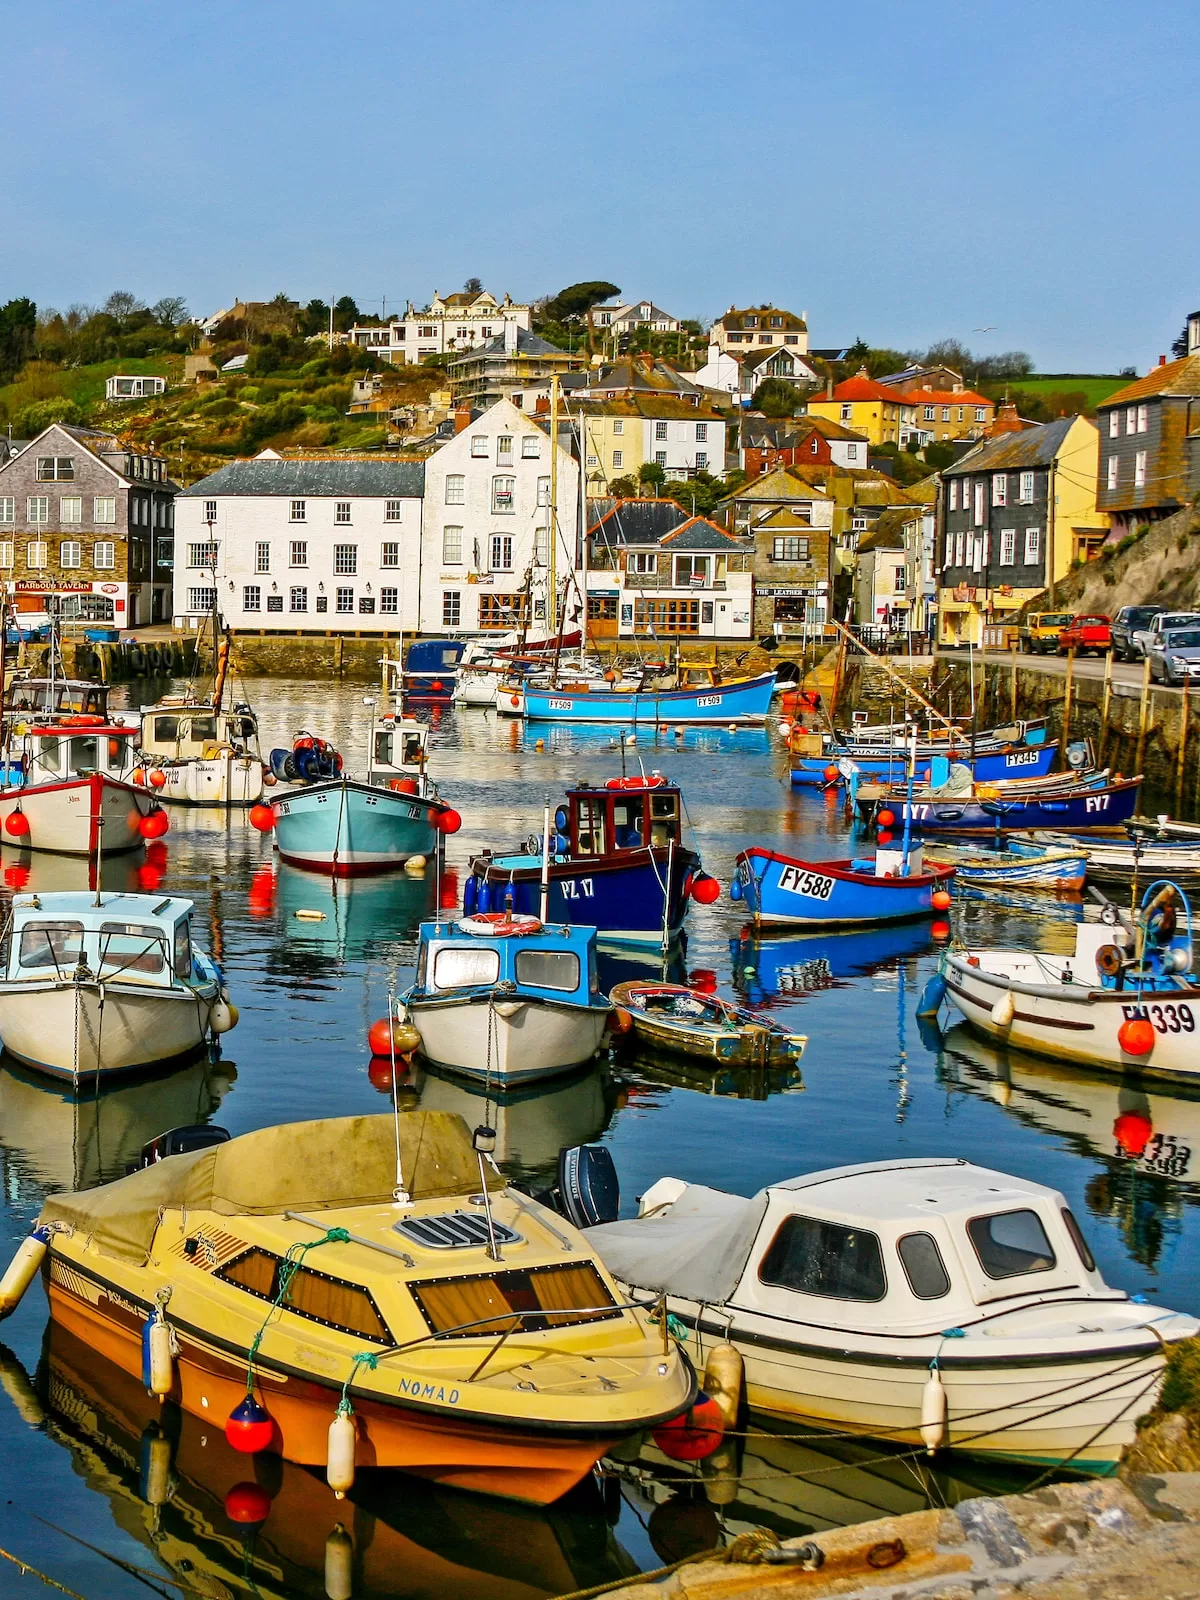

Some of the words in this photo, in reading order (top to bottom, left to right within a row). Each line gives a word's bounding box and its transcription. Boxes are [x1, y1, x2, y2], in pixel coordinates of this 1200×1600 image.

[59, 581, 89, 590] TAVERN
[1007, 752, 1038, 766] FY345
[1086, 794, 1110, 813] FY7
[560, 880, 580, 900] PZ
[580, 878, 595, 898] 17
[780, 867, 833, 899] FY588
[398, 1378, 459, 1404] NOMAD
